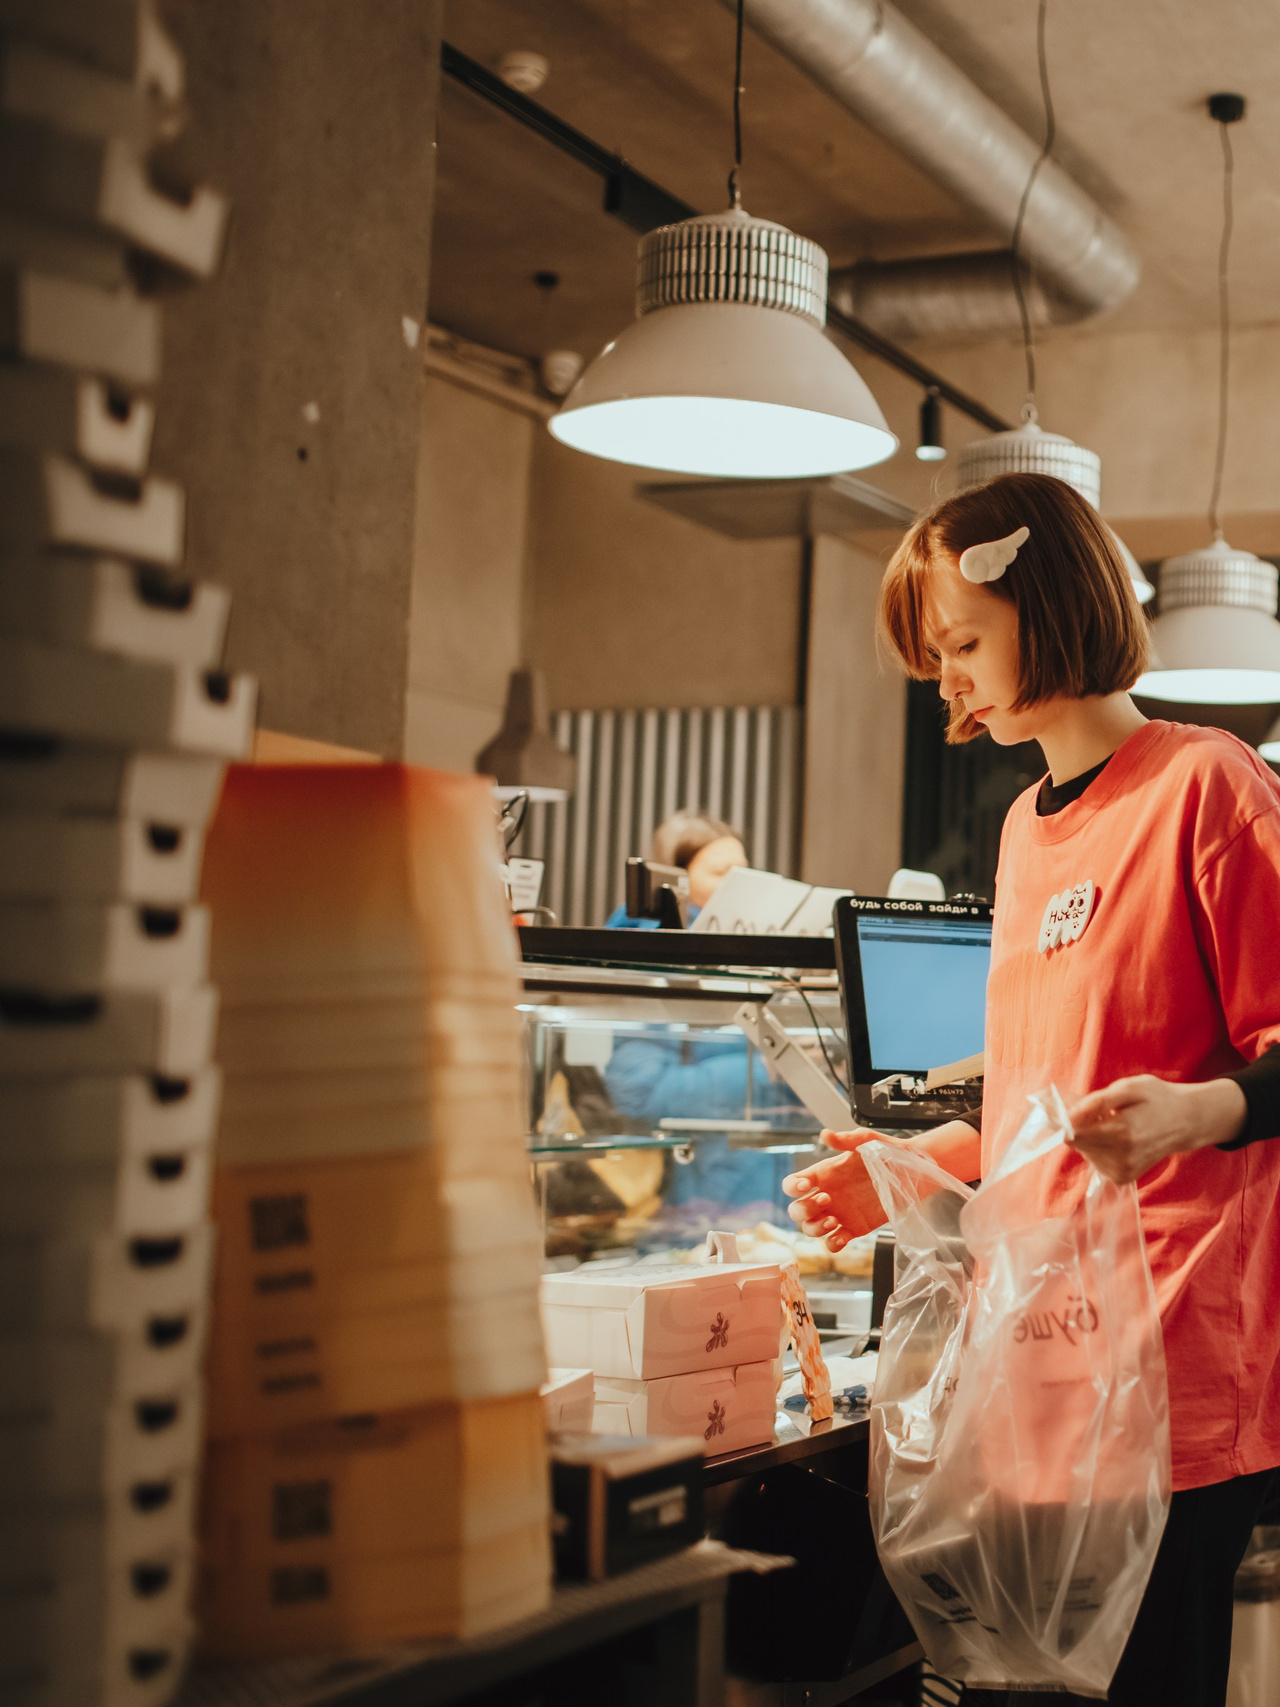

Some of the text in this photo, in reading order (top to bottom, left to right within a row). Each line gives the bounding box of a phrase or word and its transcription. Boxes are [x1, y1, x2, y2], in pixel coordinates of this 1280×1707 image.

[850, 898, 881, 910] будь
[883, 901, 923, 911] собой
[929, 903, 968, 914] зайди
